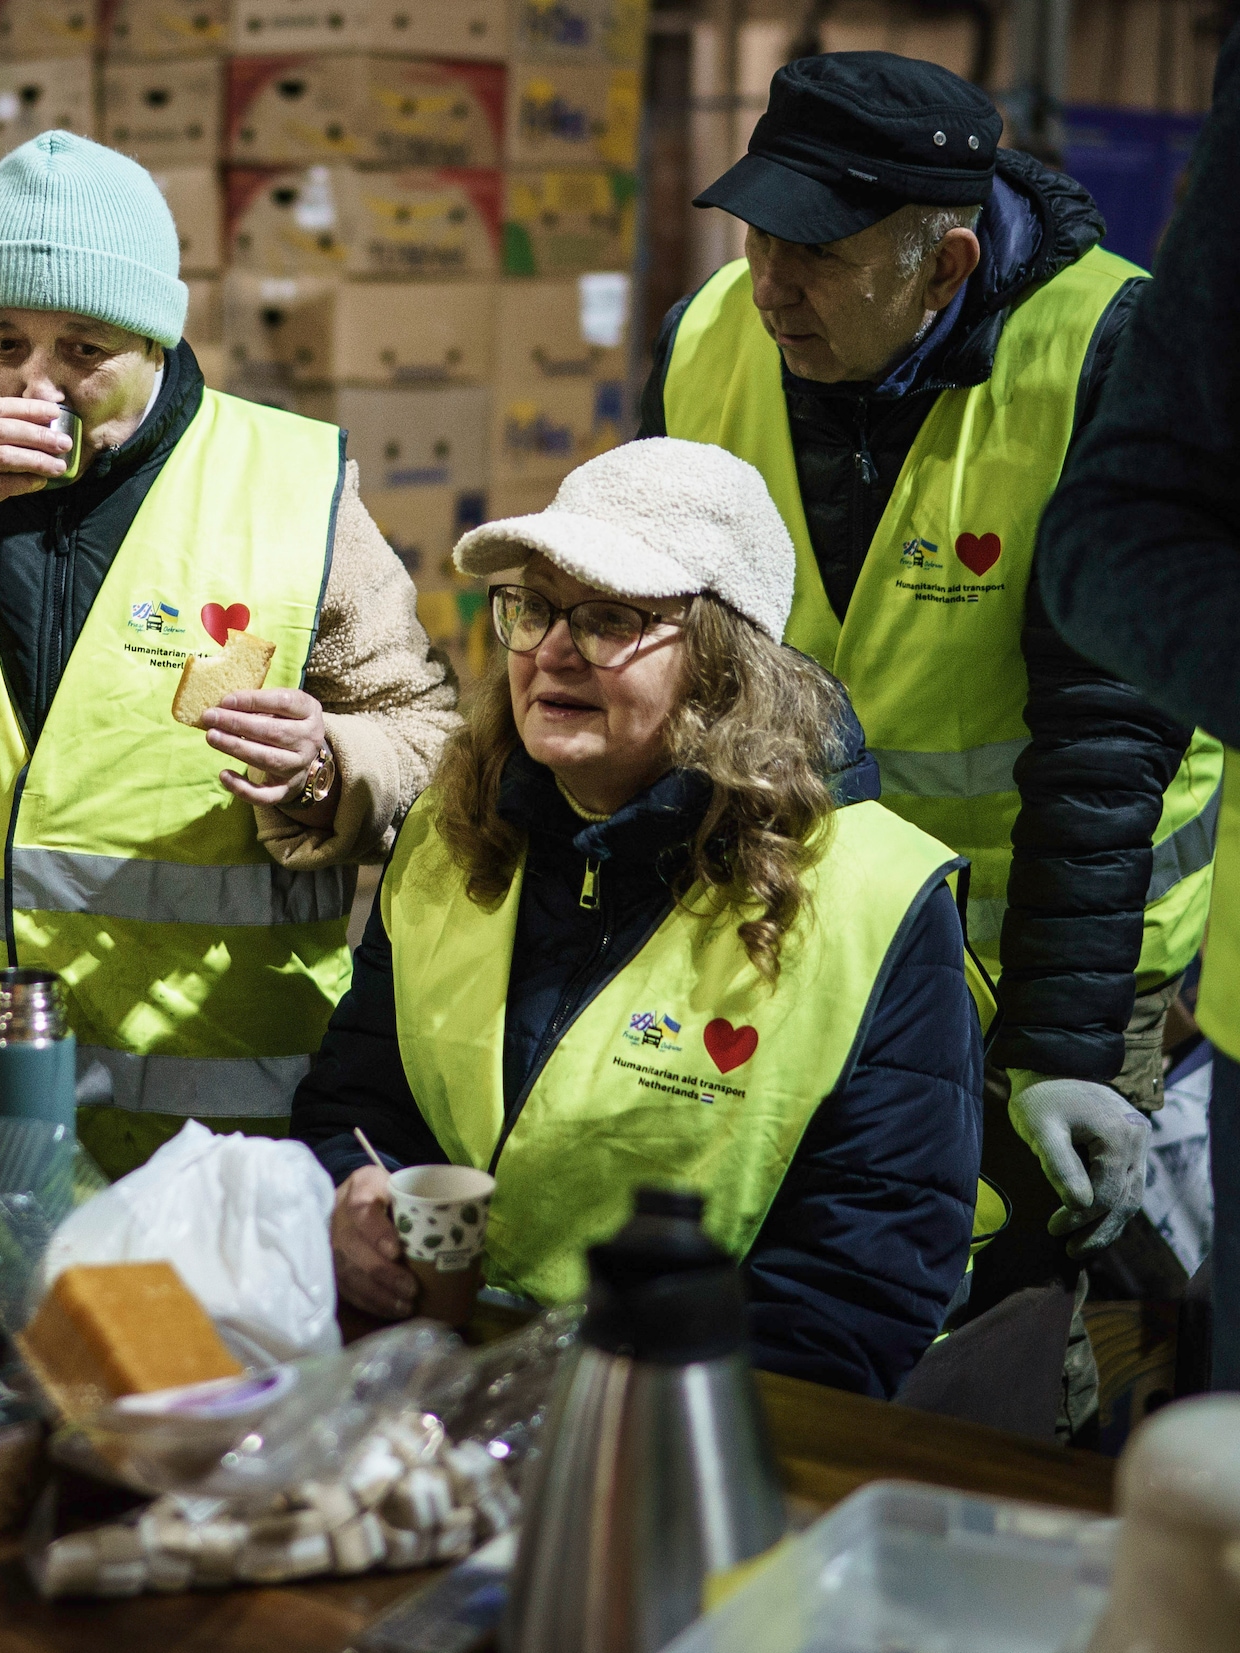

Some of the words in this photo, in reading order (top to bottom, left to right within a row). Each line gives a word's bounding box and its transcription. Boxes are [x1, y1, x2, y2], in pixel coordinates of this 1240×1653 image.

[947, 583, 962, 593] aid
[963, 583, 1005, 593] transport
[915, 593, 966, 604] Netherlands
[124, 643, 186, 658] Humanitarian
[150, 658, 185, 670] Netherl
[613, 1056, 679, 1082] Humanitarian
[681, 1074, 698, 1086] aid
[699, 1078, 746, 1099] transport
[638, 1076, 699, 1100] Netherlands
